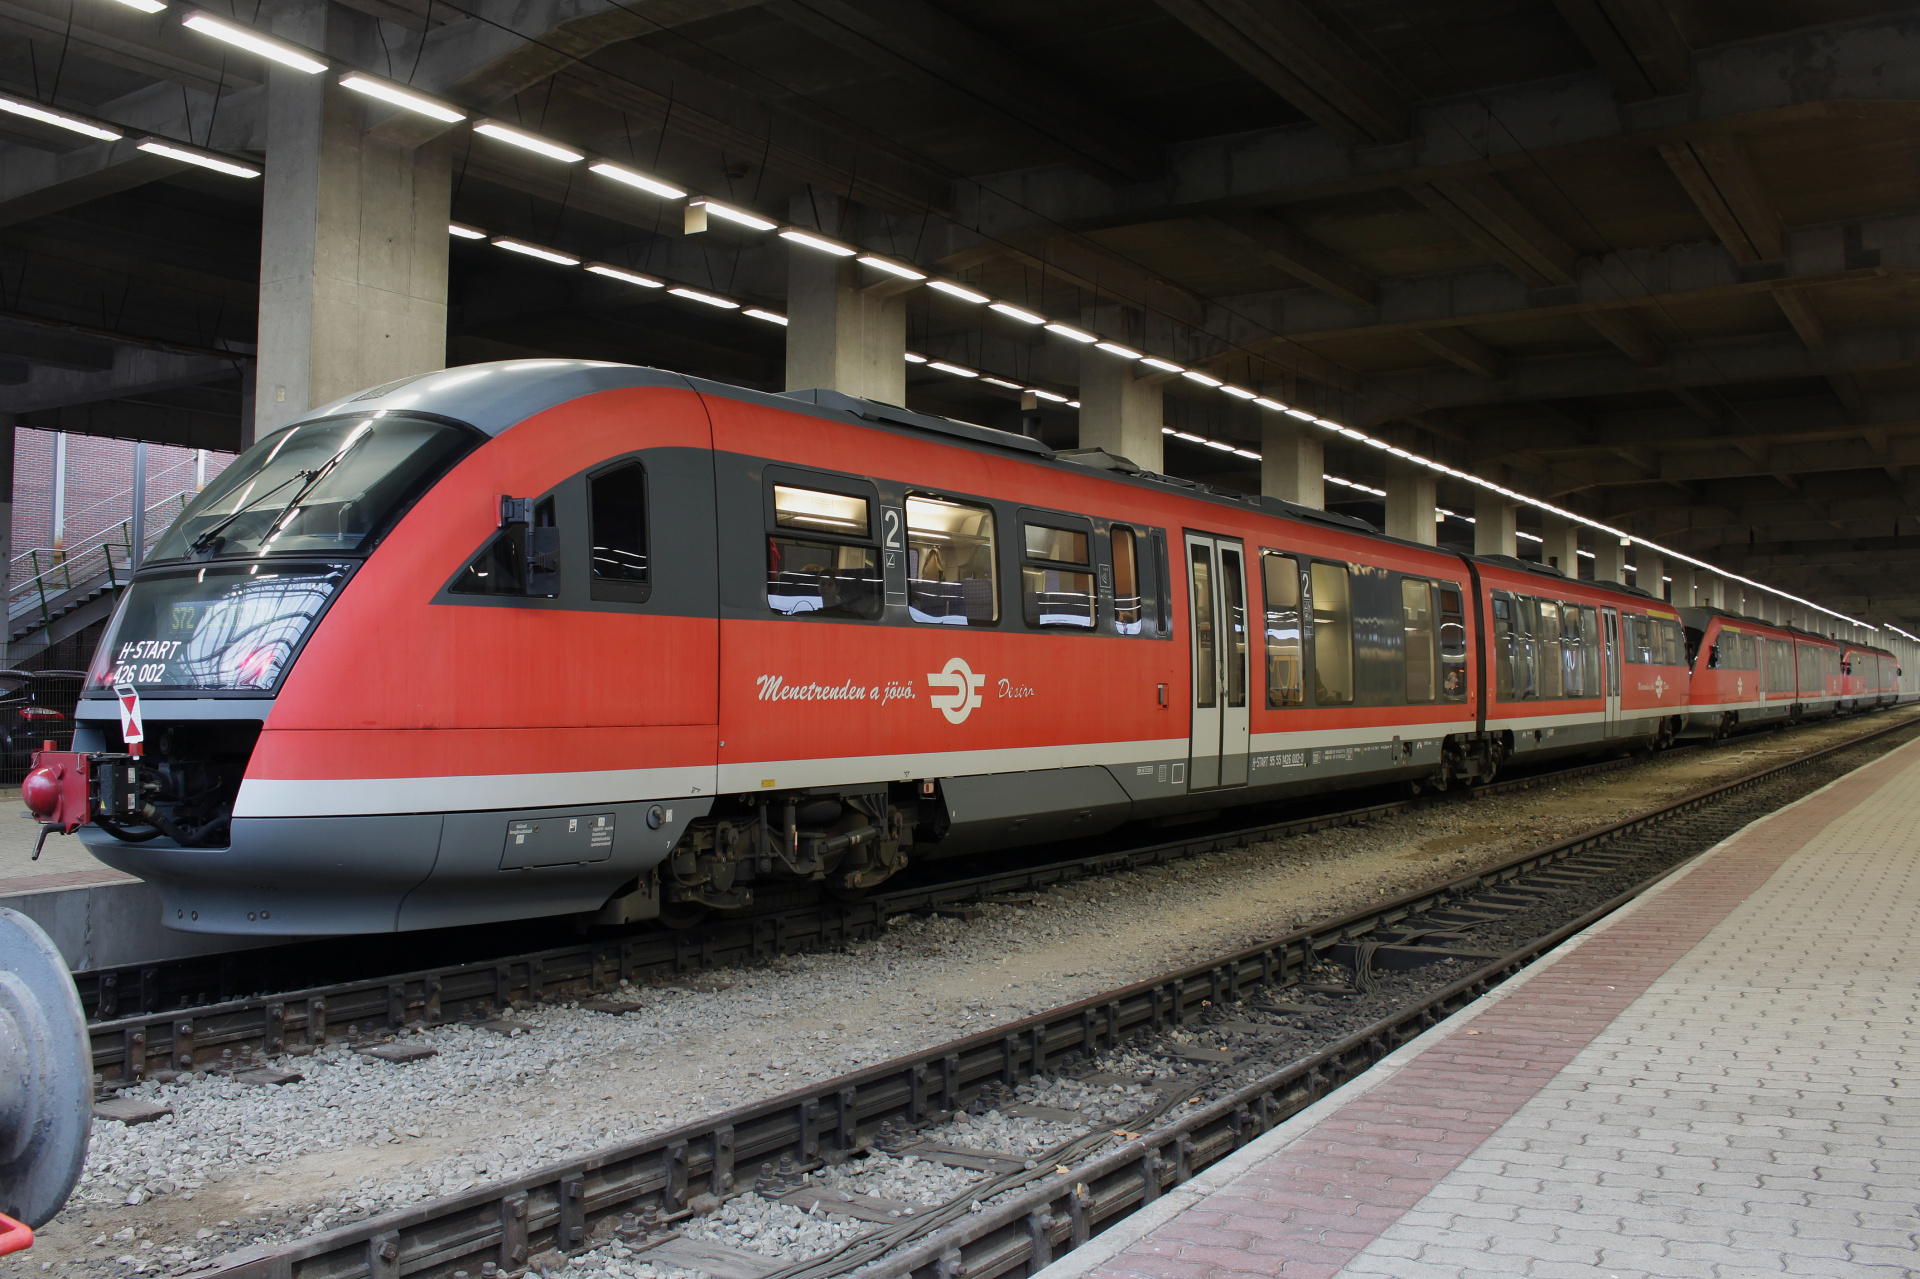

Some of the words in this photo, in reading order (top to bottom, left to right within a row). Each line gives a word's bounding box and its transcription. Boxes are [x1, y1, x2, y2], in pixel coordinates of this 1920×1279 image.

[885, 510, 900, 547] 2
[1302, 573, 1310, 597] 2
[172, 606, 195, 630] S72
[117, 640, 182, 661] H-START
[113, 664, 135, 684] 426
[138, 663, 166, 683] 002
[756, 674, 867, 702] Menetrenden
[869, 686, 880, 700] a
